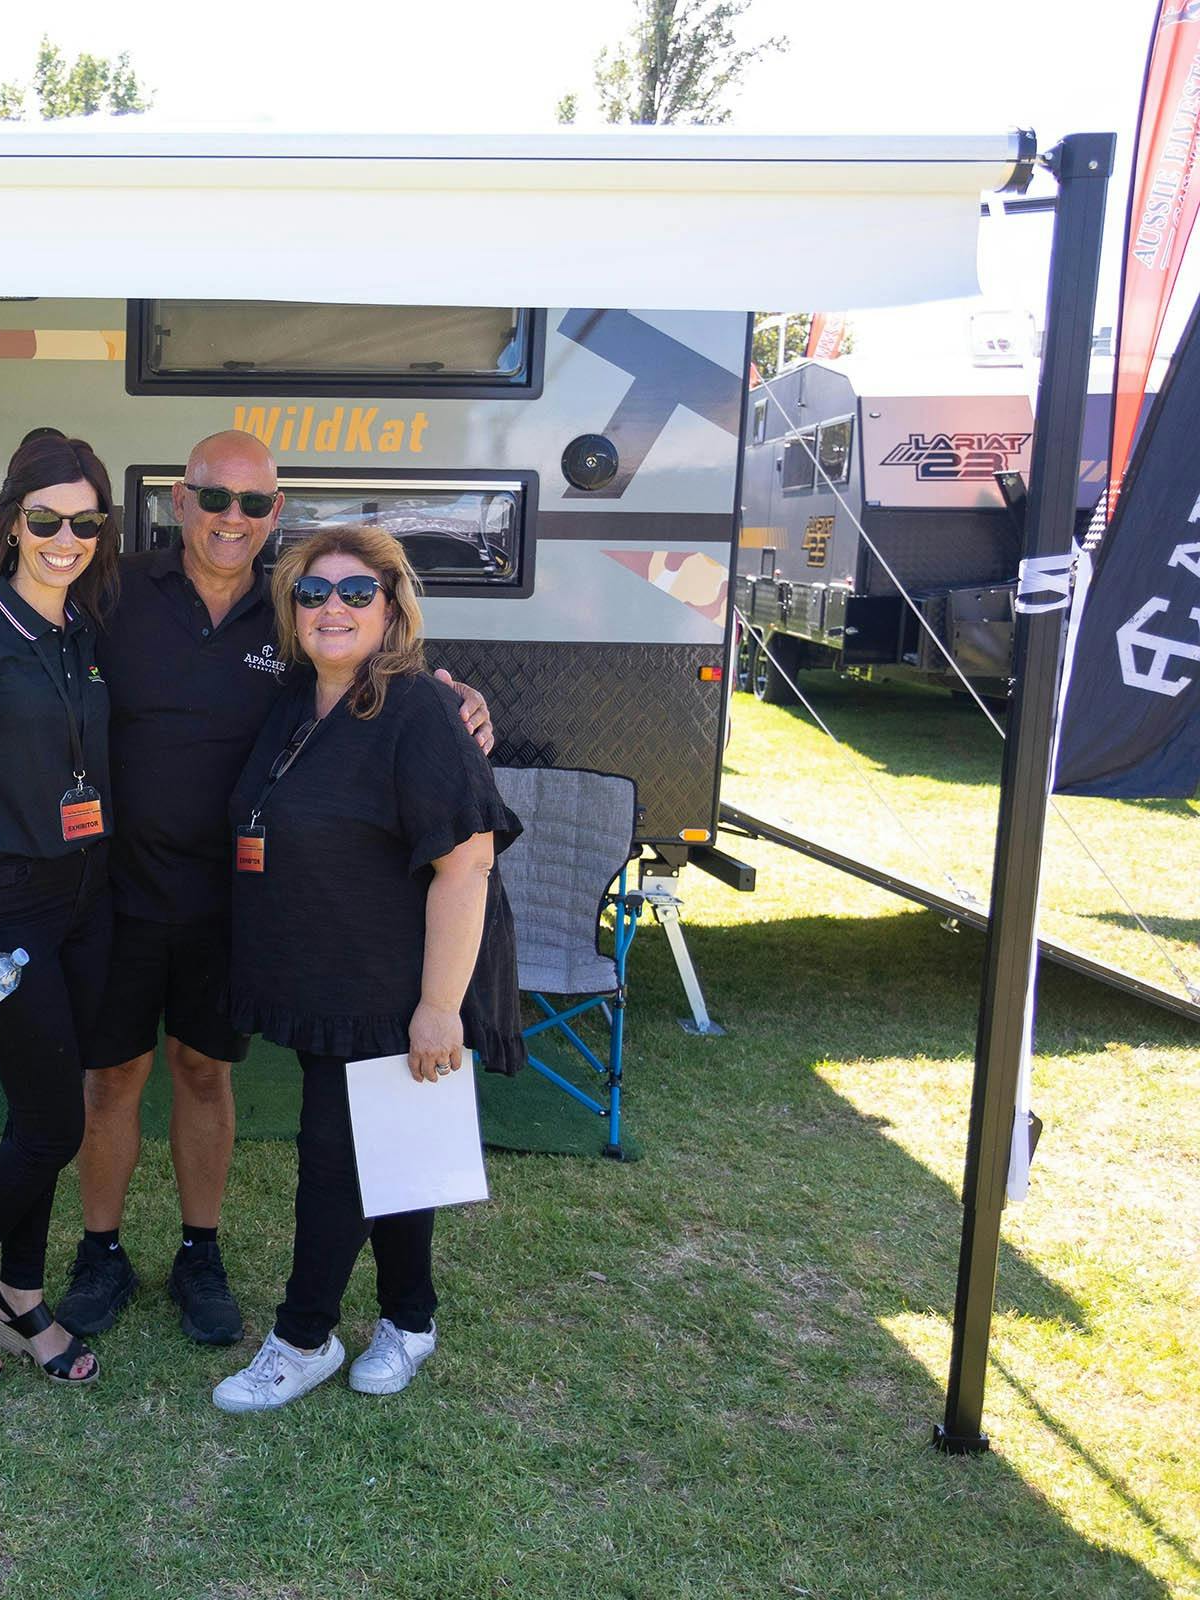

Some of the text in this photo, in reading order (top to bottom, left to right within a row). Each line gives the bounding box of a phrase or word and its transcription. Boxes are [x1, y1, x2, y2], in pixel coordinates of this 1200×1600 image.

[1132, 169, 1182, 270] AUSSIE
[233, 405, 430, 453] WildKat
[911, 435, 1028, 451] LARIAT
[919, 451, 1005, 479] 23
[243, 653, 286, 672] APACHE
[68, 820, 99, 832] EXHIBITOR
